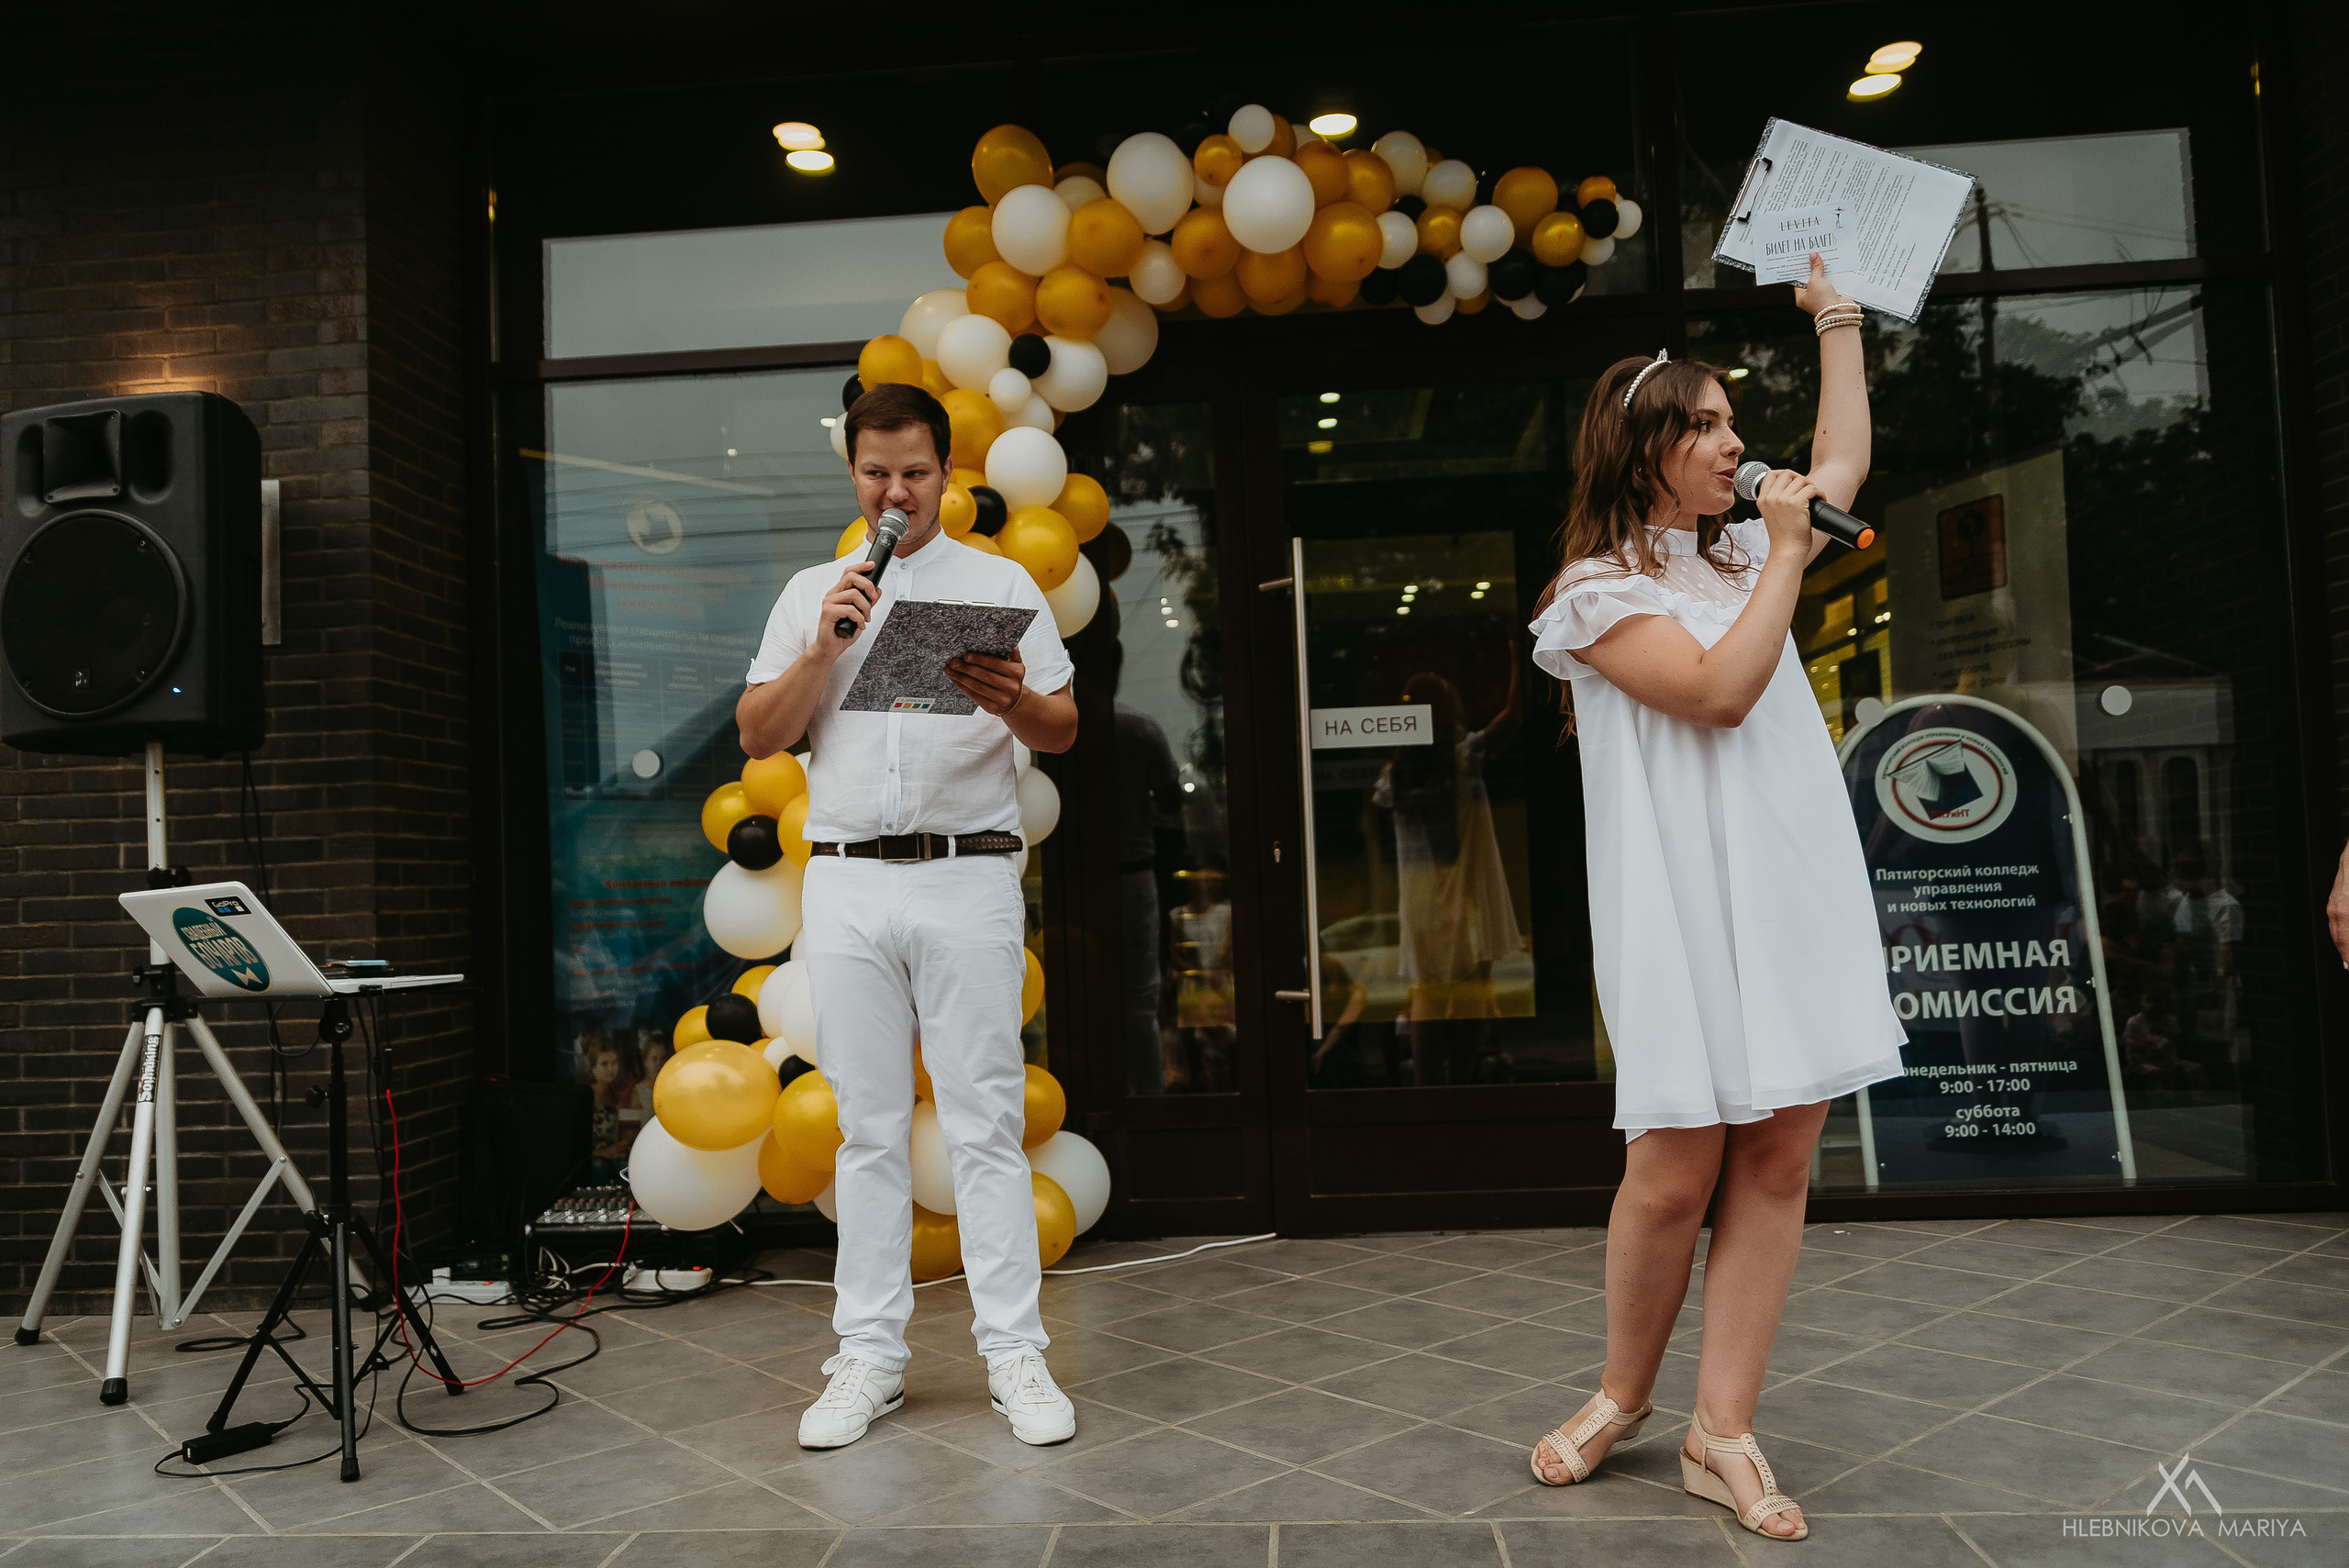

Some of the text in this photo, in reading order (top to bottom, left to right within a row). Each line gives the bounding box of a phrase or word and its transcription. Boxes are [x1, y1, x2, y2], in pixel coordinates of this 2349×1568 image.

[1765, 239, 1790, 256] БИЛЕТ
[1794, 238, 1806, 251] НА
[1325, 716, 1418, 736] НА СЕБЯ
[1876, 864, 2039, 882] Пятигорский колледж
[1913, 883, 2002, 899] управления
[211, 900, 239, 908] GoPro
[1887, 895, 2036, 913] и новых технологий
[188, 936, 259, 970] БОЧАРОВ
[1893, 985, 2078, 1020] ОМИССИЯ
[1903, 1063, 1997, 1078] онедельник
[2009, 1061, 2078, 1073] пятница
[1940, 1081, 1974, 1094] 9:00
[1987, 1078, 2031, 1092] 17:00
[1955, 1104, 2021, 1122] суббота
[1944, 1124, 1979, 1138] 9:00
[1992, 1122, 2036, 1136] 14:00
